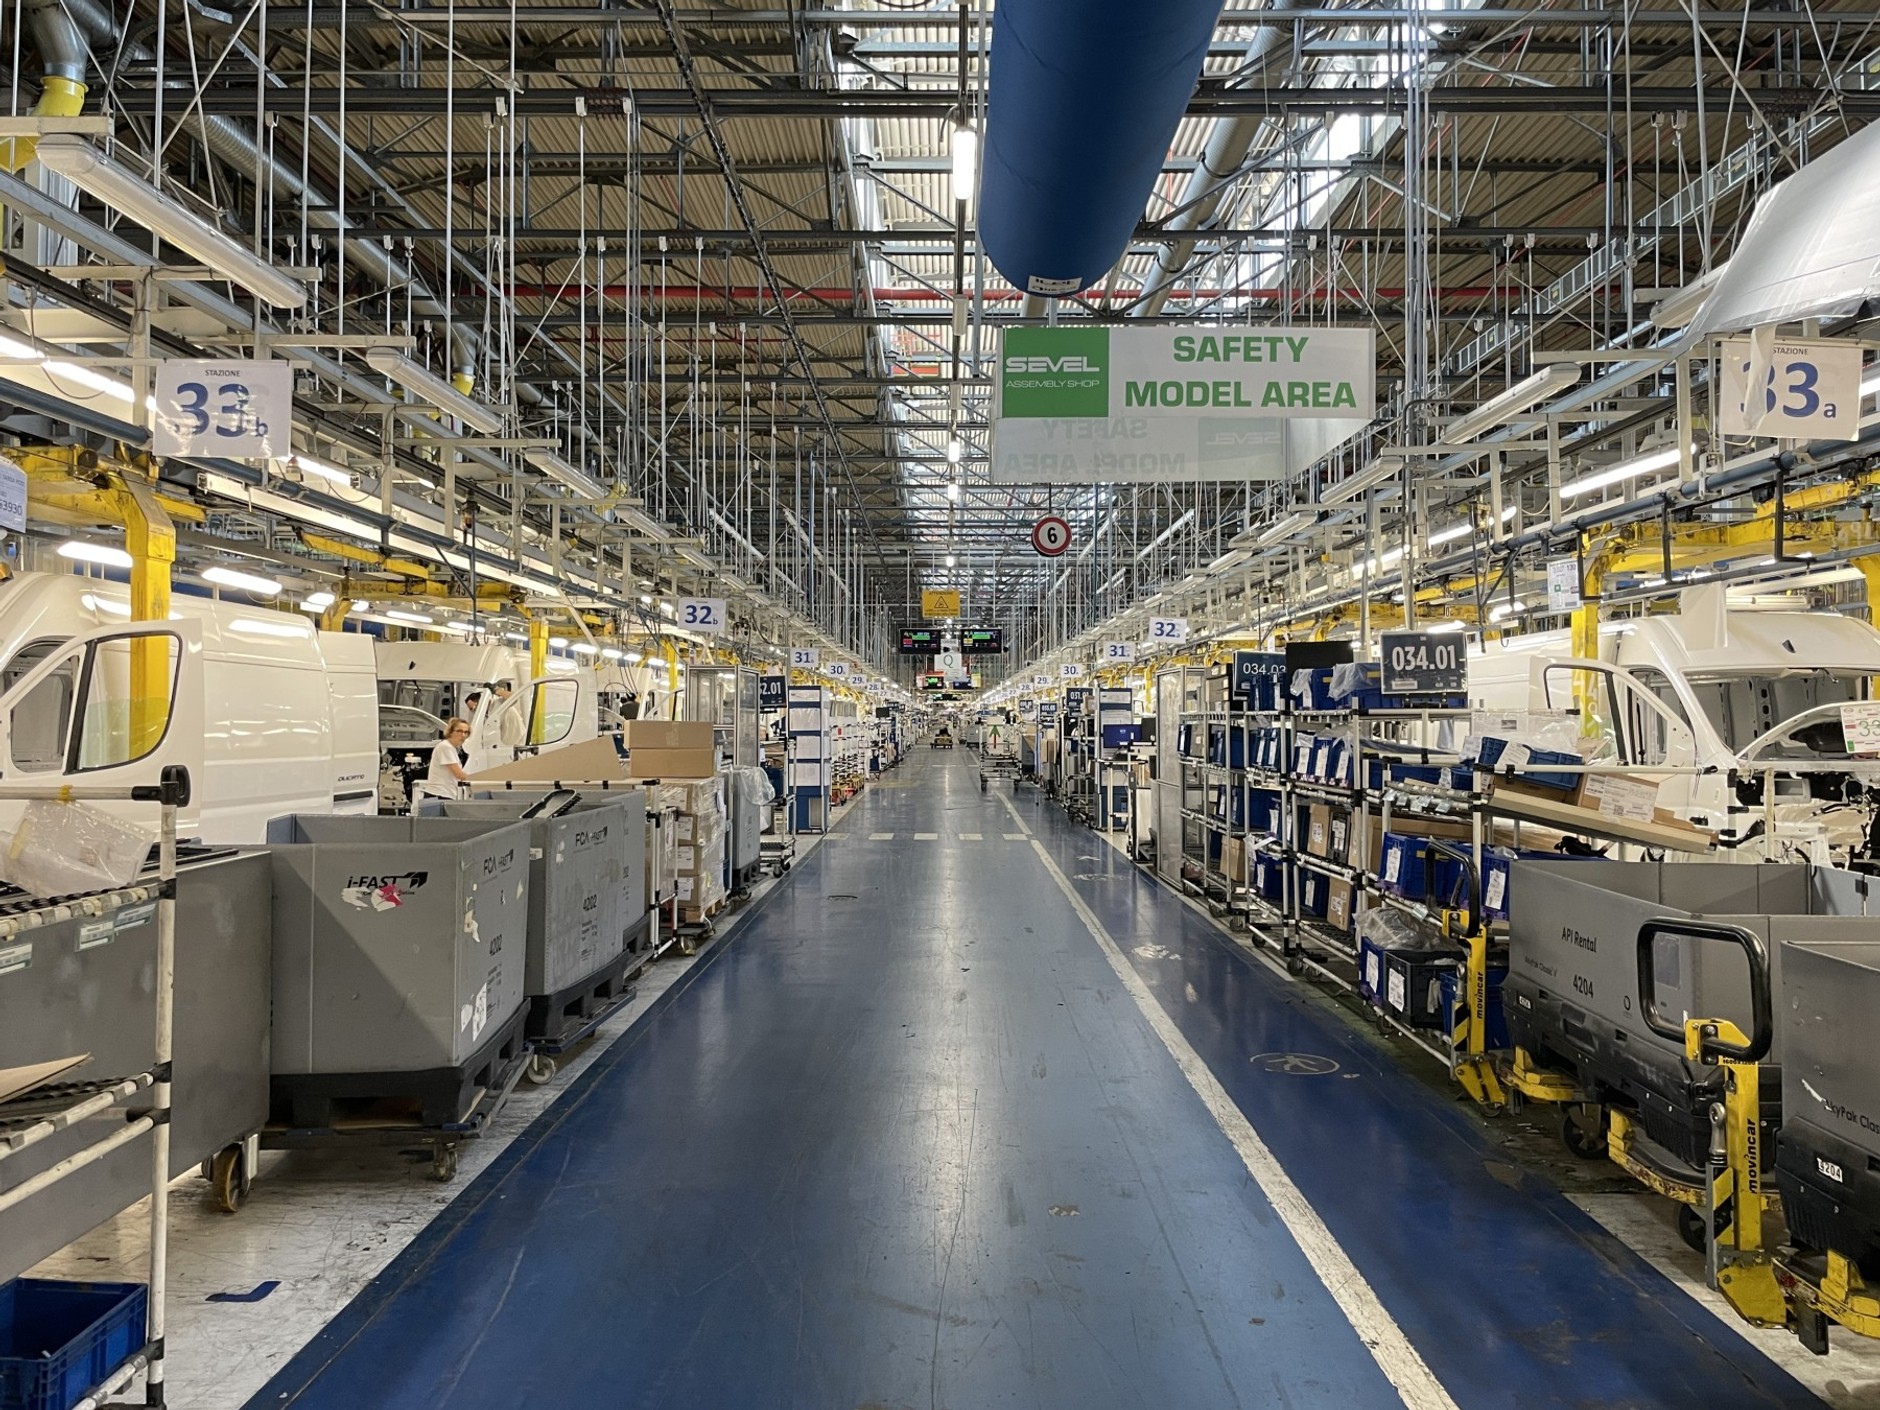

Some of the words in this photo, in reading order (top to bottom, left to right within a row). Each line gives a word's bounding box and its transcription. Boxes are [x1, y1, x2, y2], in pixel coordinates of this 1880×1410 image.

[1173, 336, 1309, 363] SAFETY
[205, 369, 241, 378] STAZIONE
[1006, 356, 1100, 373] SEVEL
[1005, 380, 1067, 388] ASSEMBLY
[1067, 380, 1100, 388] SHOP
[1125, 381, 1252, 408] MODEL
[1261, 381, 1357, 408] AREA
[0, 500, 22, 516] 3930
[1047, 526, 1058, 544] 6
[943, 654, 953, 668] Q
[1391, 644, 1457, 671] 034.01
[346, 875, 398, 889] i-FAST
[1561, 926, 1573, 943] API
[1573, 930, 1597, 953] Rental
[1475, 971, 1484, 1019] movincar
[1573, 974, 1594, 999] 4204
[1743, 1118, 1758, 1195] movincar
